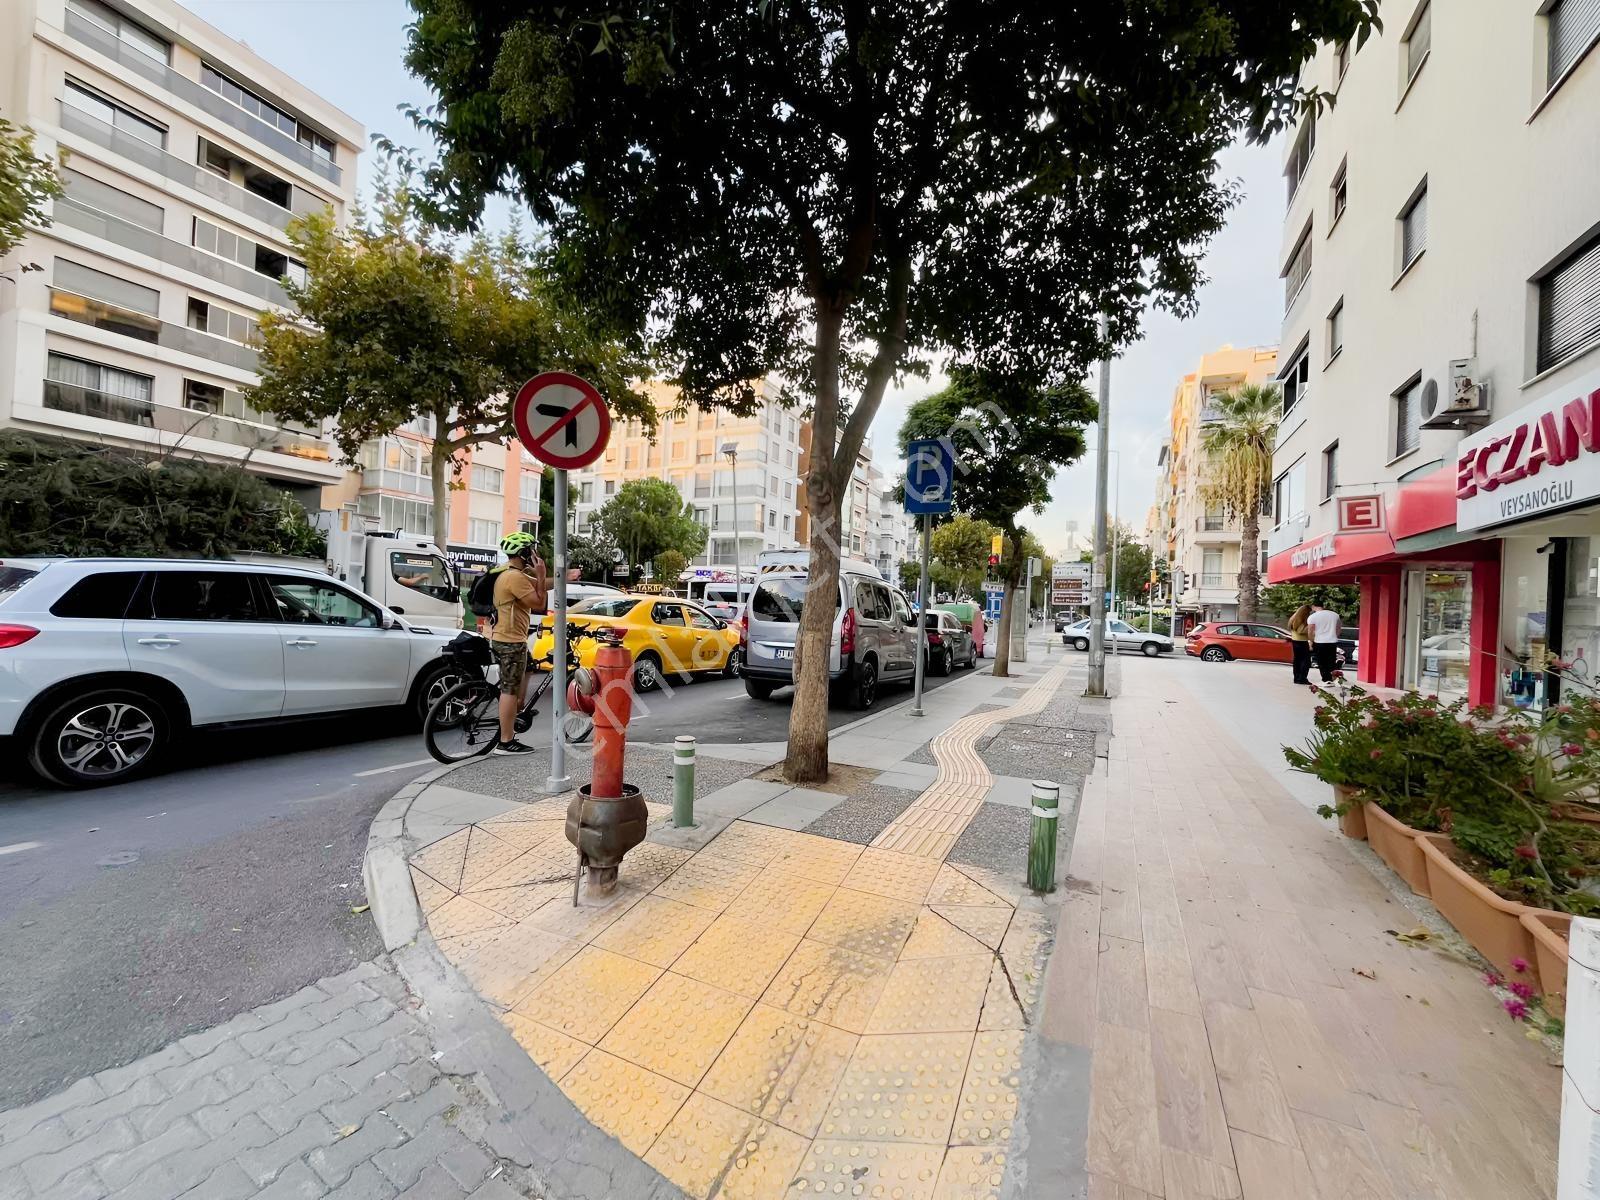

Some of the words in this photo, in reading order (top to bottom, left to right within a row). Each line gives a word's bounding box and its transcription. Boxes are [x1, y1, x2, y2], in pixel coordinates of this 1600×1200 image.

[917, 446, 943, 485] P
[1347, 502, 1372, 526] E
[1500, 480, 1573, 517] VEYSANOĞLU
